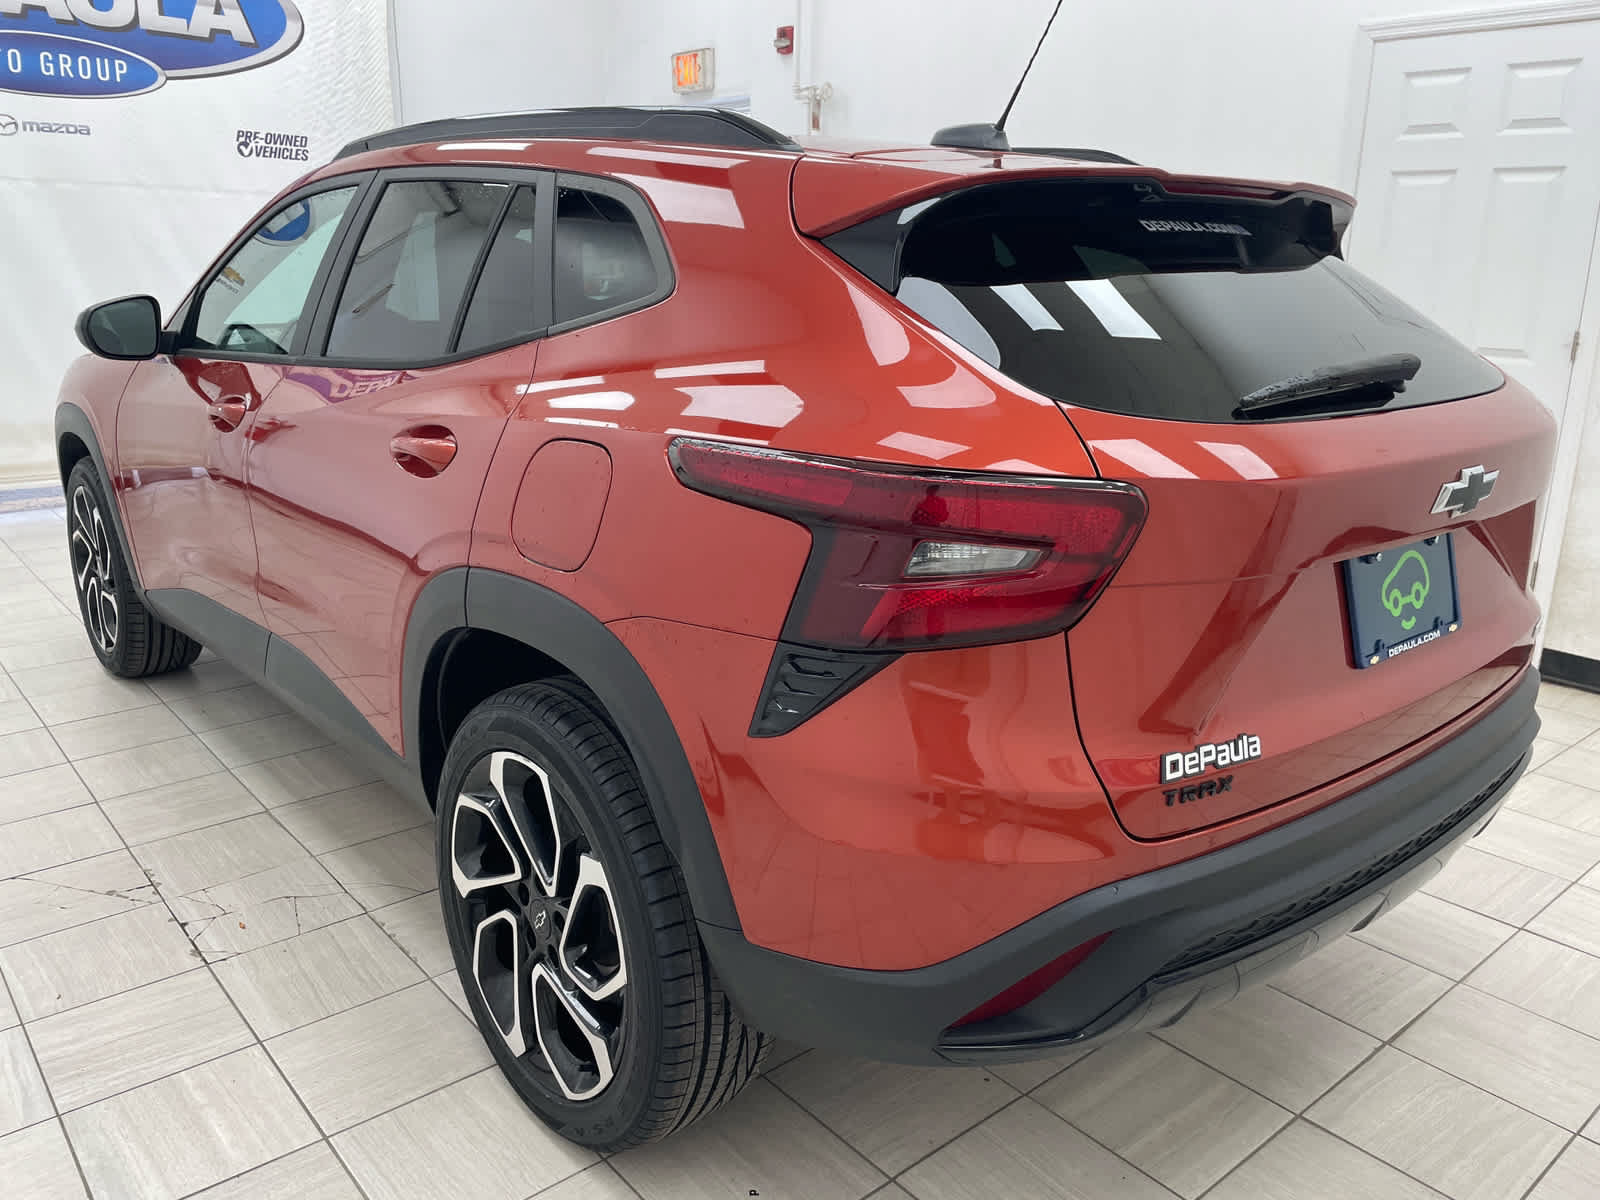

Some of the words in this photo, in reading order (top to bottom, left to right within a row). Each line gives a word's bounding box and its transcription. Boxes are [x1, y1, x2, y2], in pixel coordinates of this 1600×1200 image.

[40, 51, 127, 82] GROUP
[675, 53, 699, 86] EXIT
[236, 130, 308, 148] PRE-OWNED
[255, 145, 309, 161] VEHICLES
[1388, 630, 1441, 658] DEPAULA.COM
[1162, 734, 1262, 782] DePaula
[1162, 775, 1235, 807] TRAX
